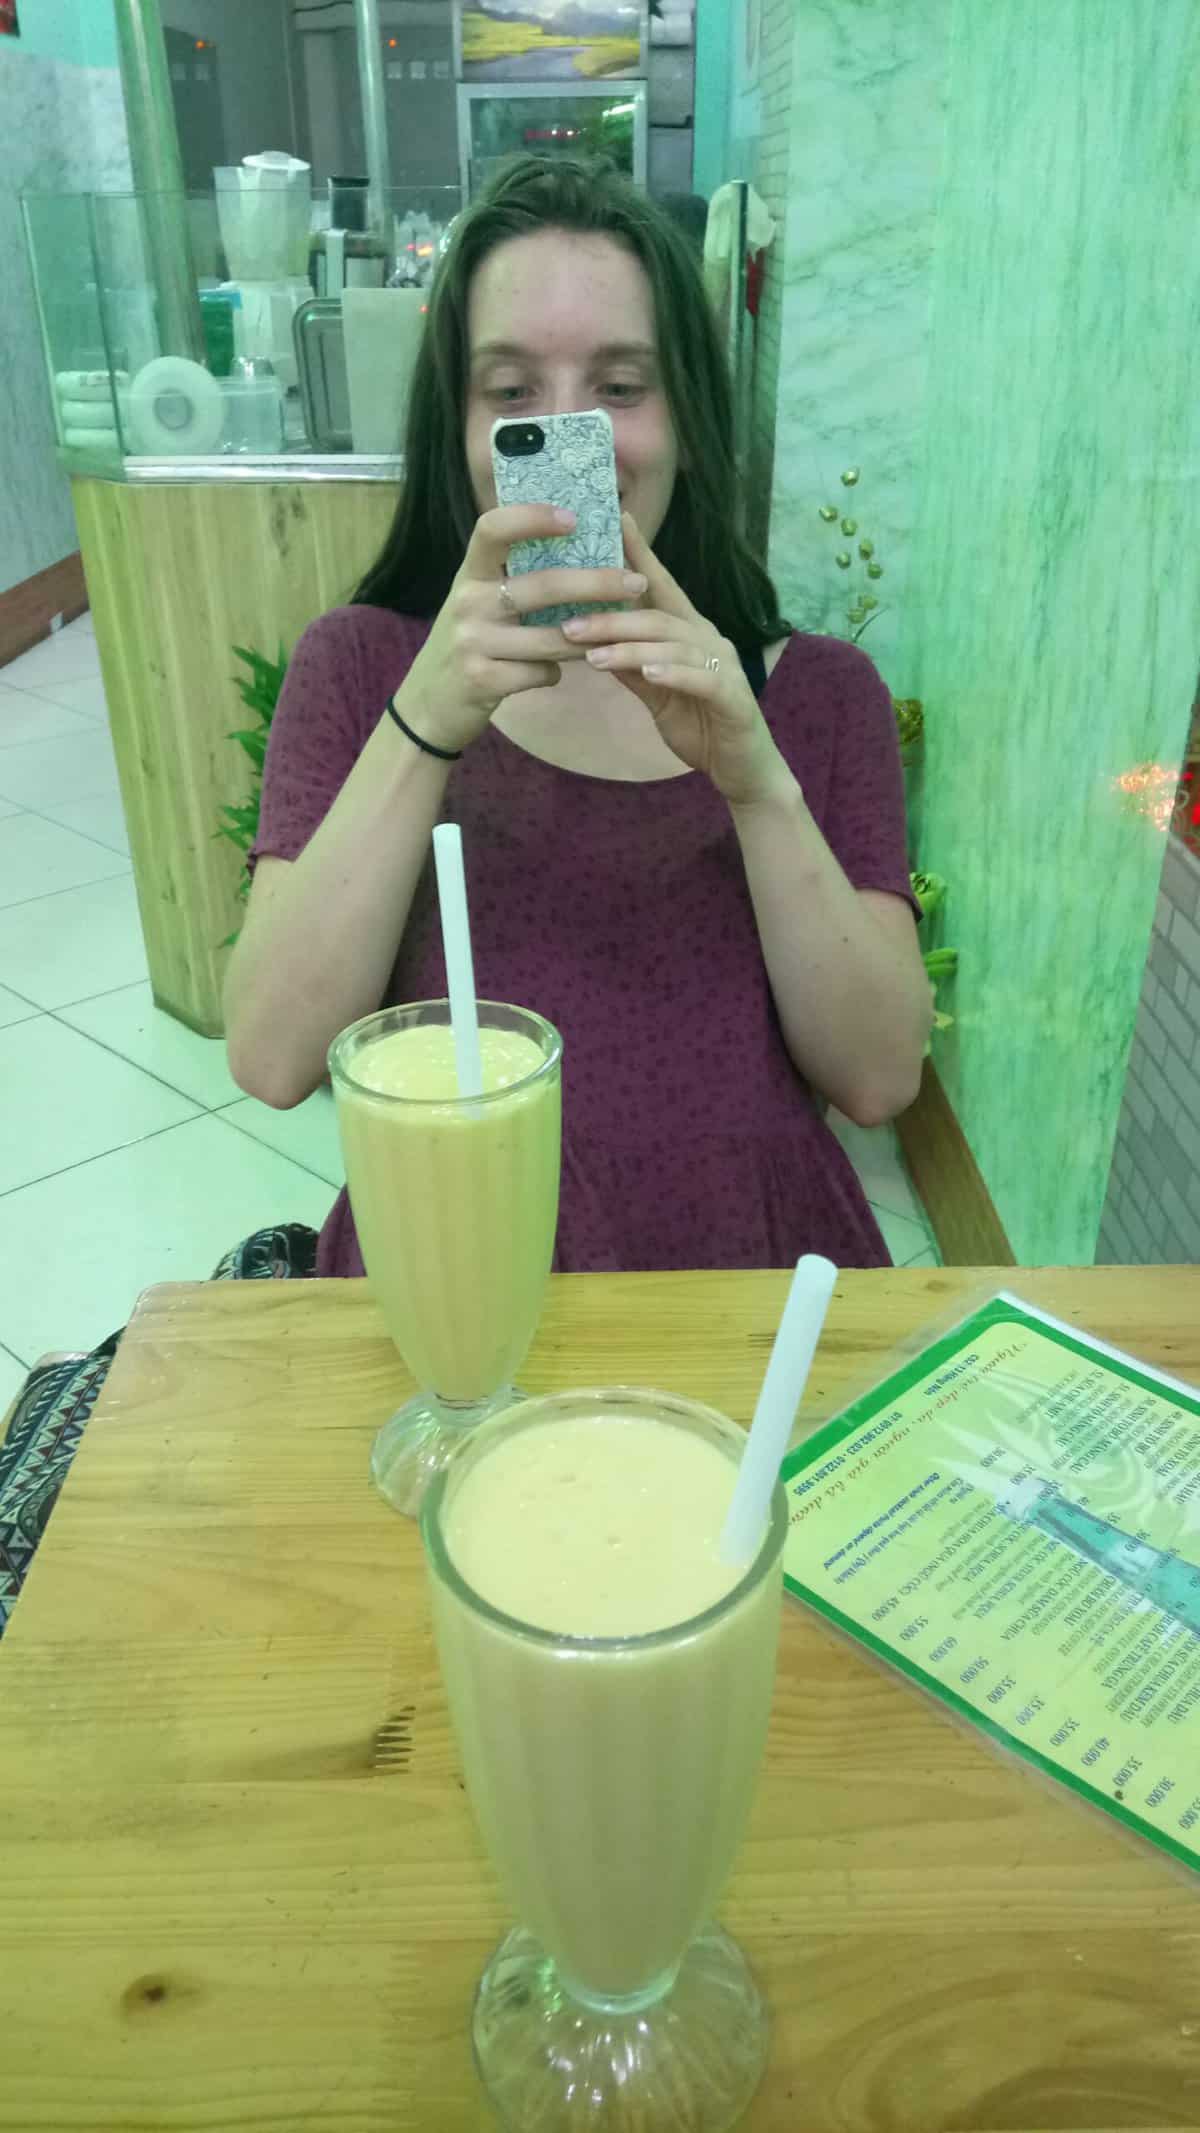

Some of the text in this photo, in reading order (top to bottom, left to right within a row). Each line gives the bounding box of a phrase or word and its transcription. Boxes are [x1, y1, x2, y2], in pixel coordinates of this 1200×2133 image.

[897, 1614, 930, 1642] 55.000
[957, 1655, 990, 1684] 50.000
[983, 1674, 1017, 1704] 35.000
[1012, 1695, 1046, 1726] 35.000
[1046, 1716, 1079, 1747] 35.000
[1078, 1735, 1111, 1767] 40.000
[1110, 1755, 1142, 1787] 35.000
